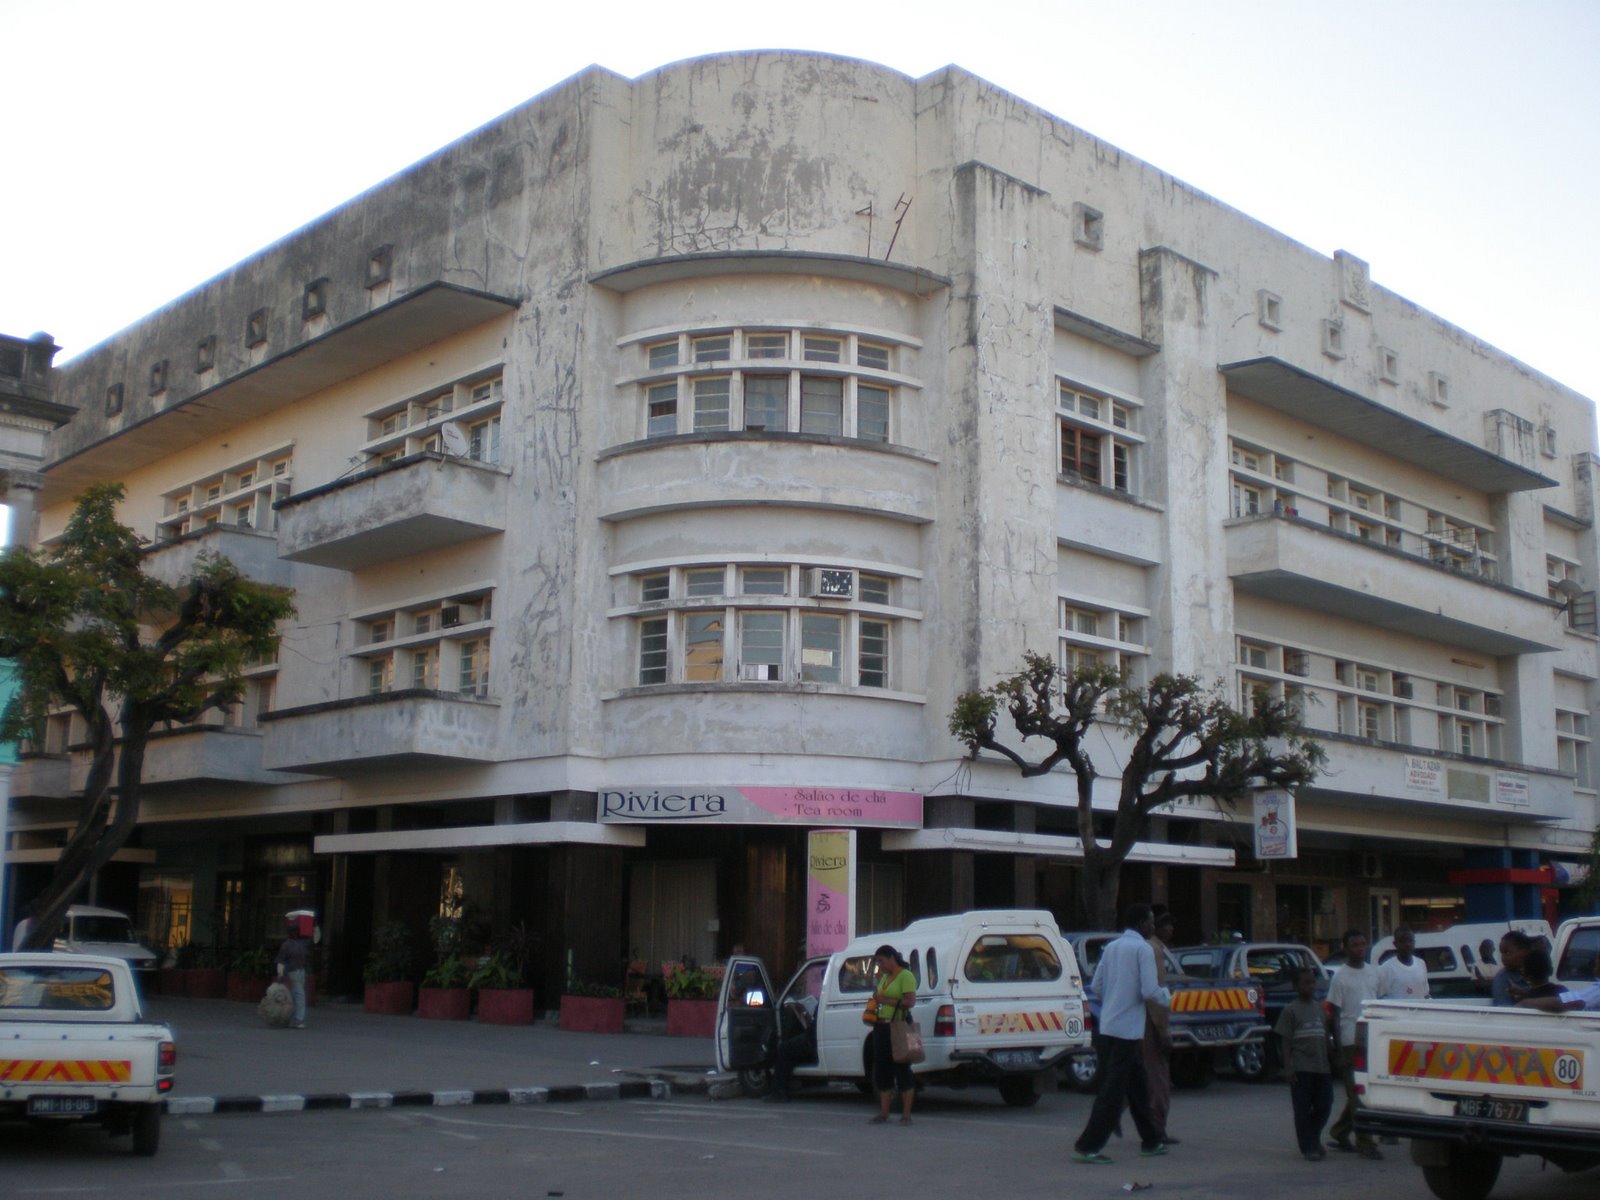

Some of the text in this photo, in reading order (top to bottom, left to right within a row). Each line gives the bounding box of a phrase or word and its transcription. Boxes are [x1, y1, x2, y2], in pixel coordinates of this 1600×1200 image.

[602, 791, 727, 818] Riviera
[794, 789, 887, 804] Salão de chá
[794, 803, 863, 818] Tea room
[1068, 1020, 1079, 1034] 80
[1412, 1042, 1549, 1078] TOYOTA
[1558, 1058, 1577, 1080] 80
[1460, 1100, 1524, 1120] MBF-76-77
